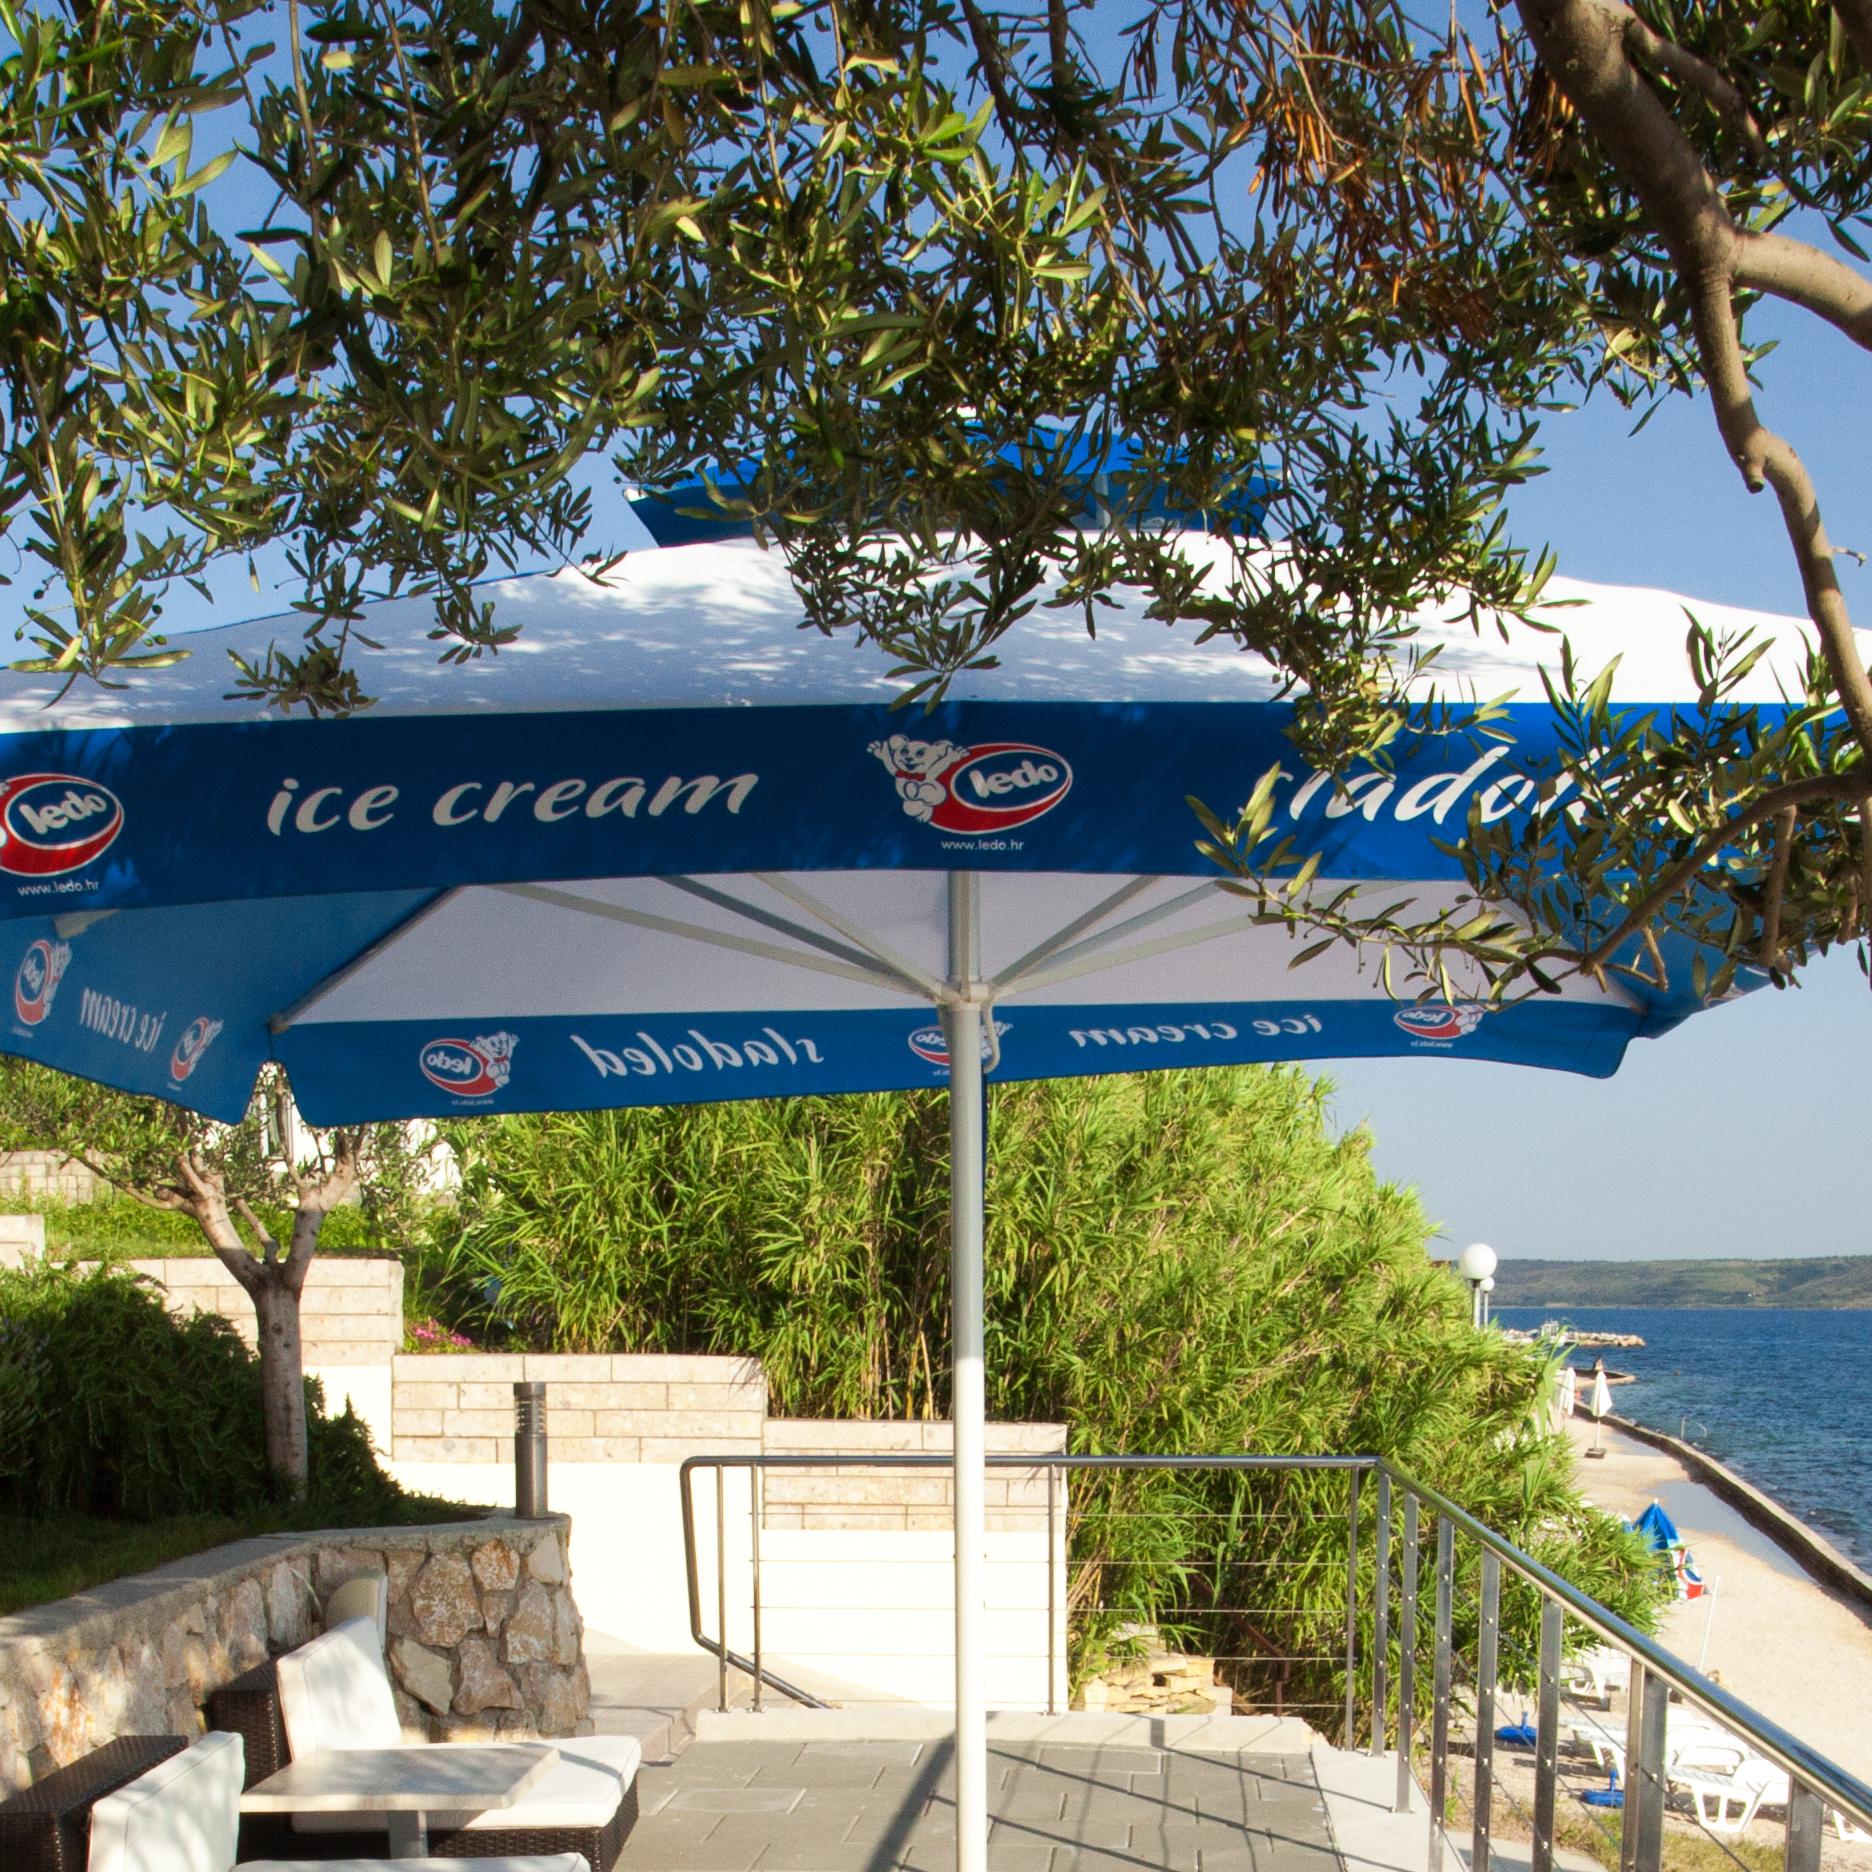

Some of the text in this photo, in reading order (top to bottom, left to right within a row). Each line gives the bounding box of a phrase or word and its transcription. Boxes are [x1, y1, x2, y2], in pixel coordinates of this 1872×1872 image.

[968, 760, 1059, 798] ledo
[18, 789, 107, 835] ledo
[265, 772, 760, 837] ice cream
[941, 838, 1025, 851] www.ledo.hr
[17, 878, 100, 897] www.ledo.hr
